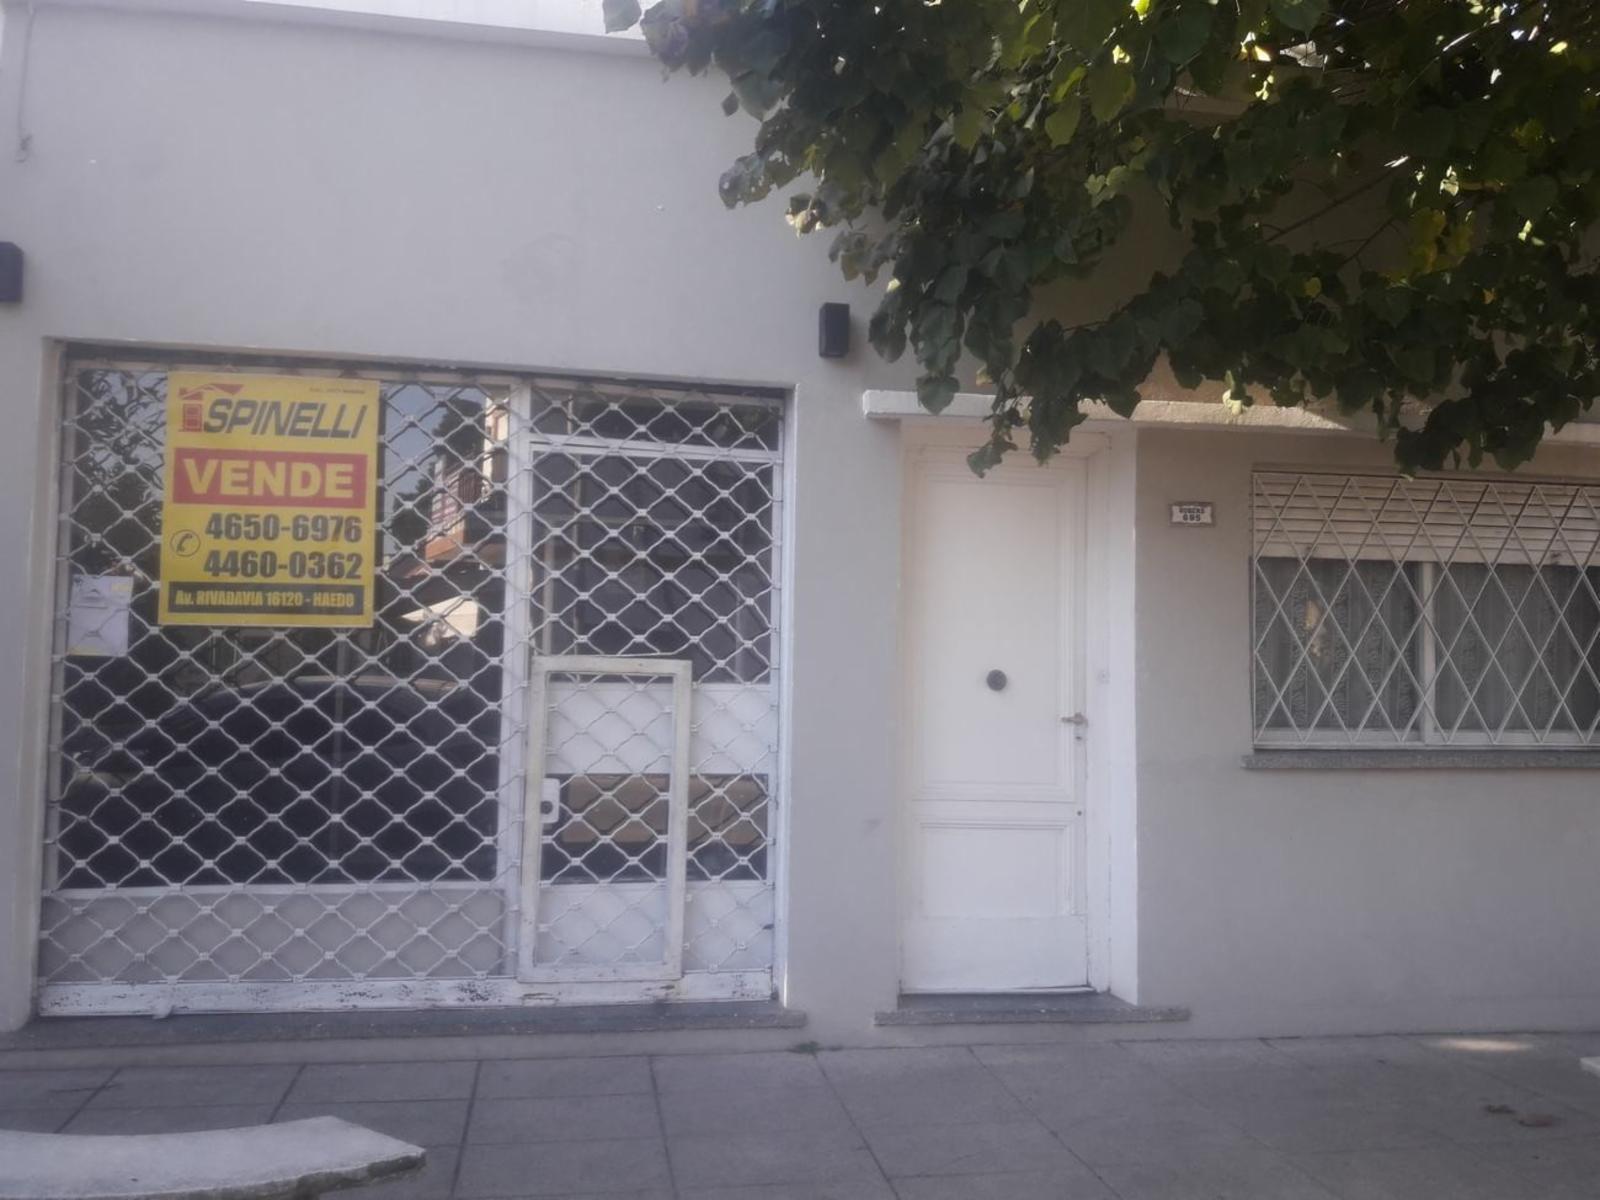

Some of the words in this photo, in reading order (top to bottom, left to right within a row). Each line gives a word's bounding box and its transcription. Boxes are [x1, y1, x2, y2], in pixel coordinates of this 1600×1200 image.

[204, 398, 367, 439] SPINELLI
[183, 458, 354, 498] VENDE
[205, 513, 362, 543] 4650-6976
[204, 549, 362, 579] 4460-0362
[176, 590, 194, 604] Av.
[196, 590, 263, 606] RIVADAVIA
[267, 592, 302, 607] 16120
[313, 592, 354, 608] HAEDO
